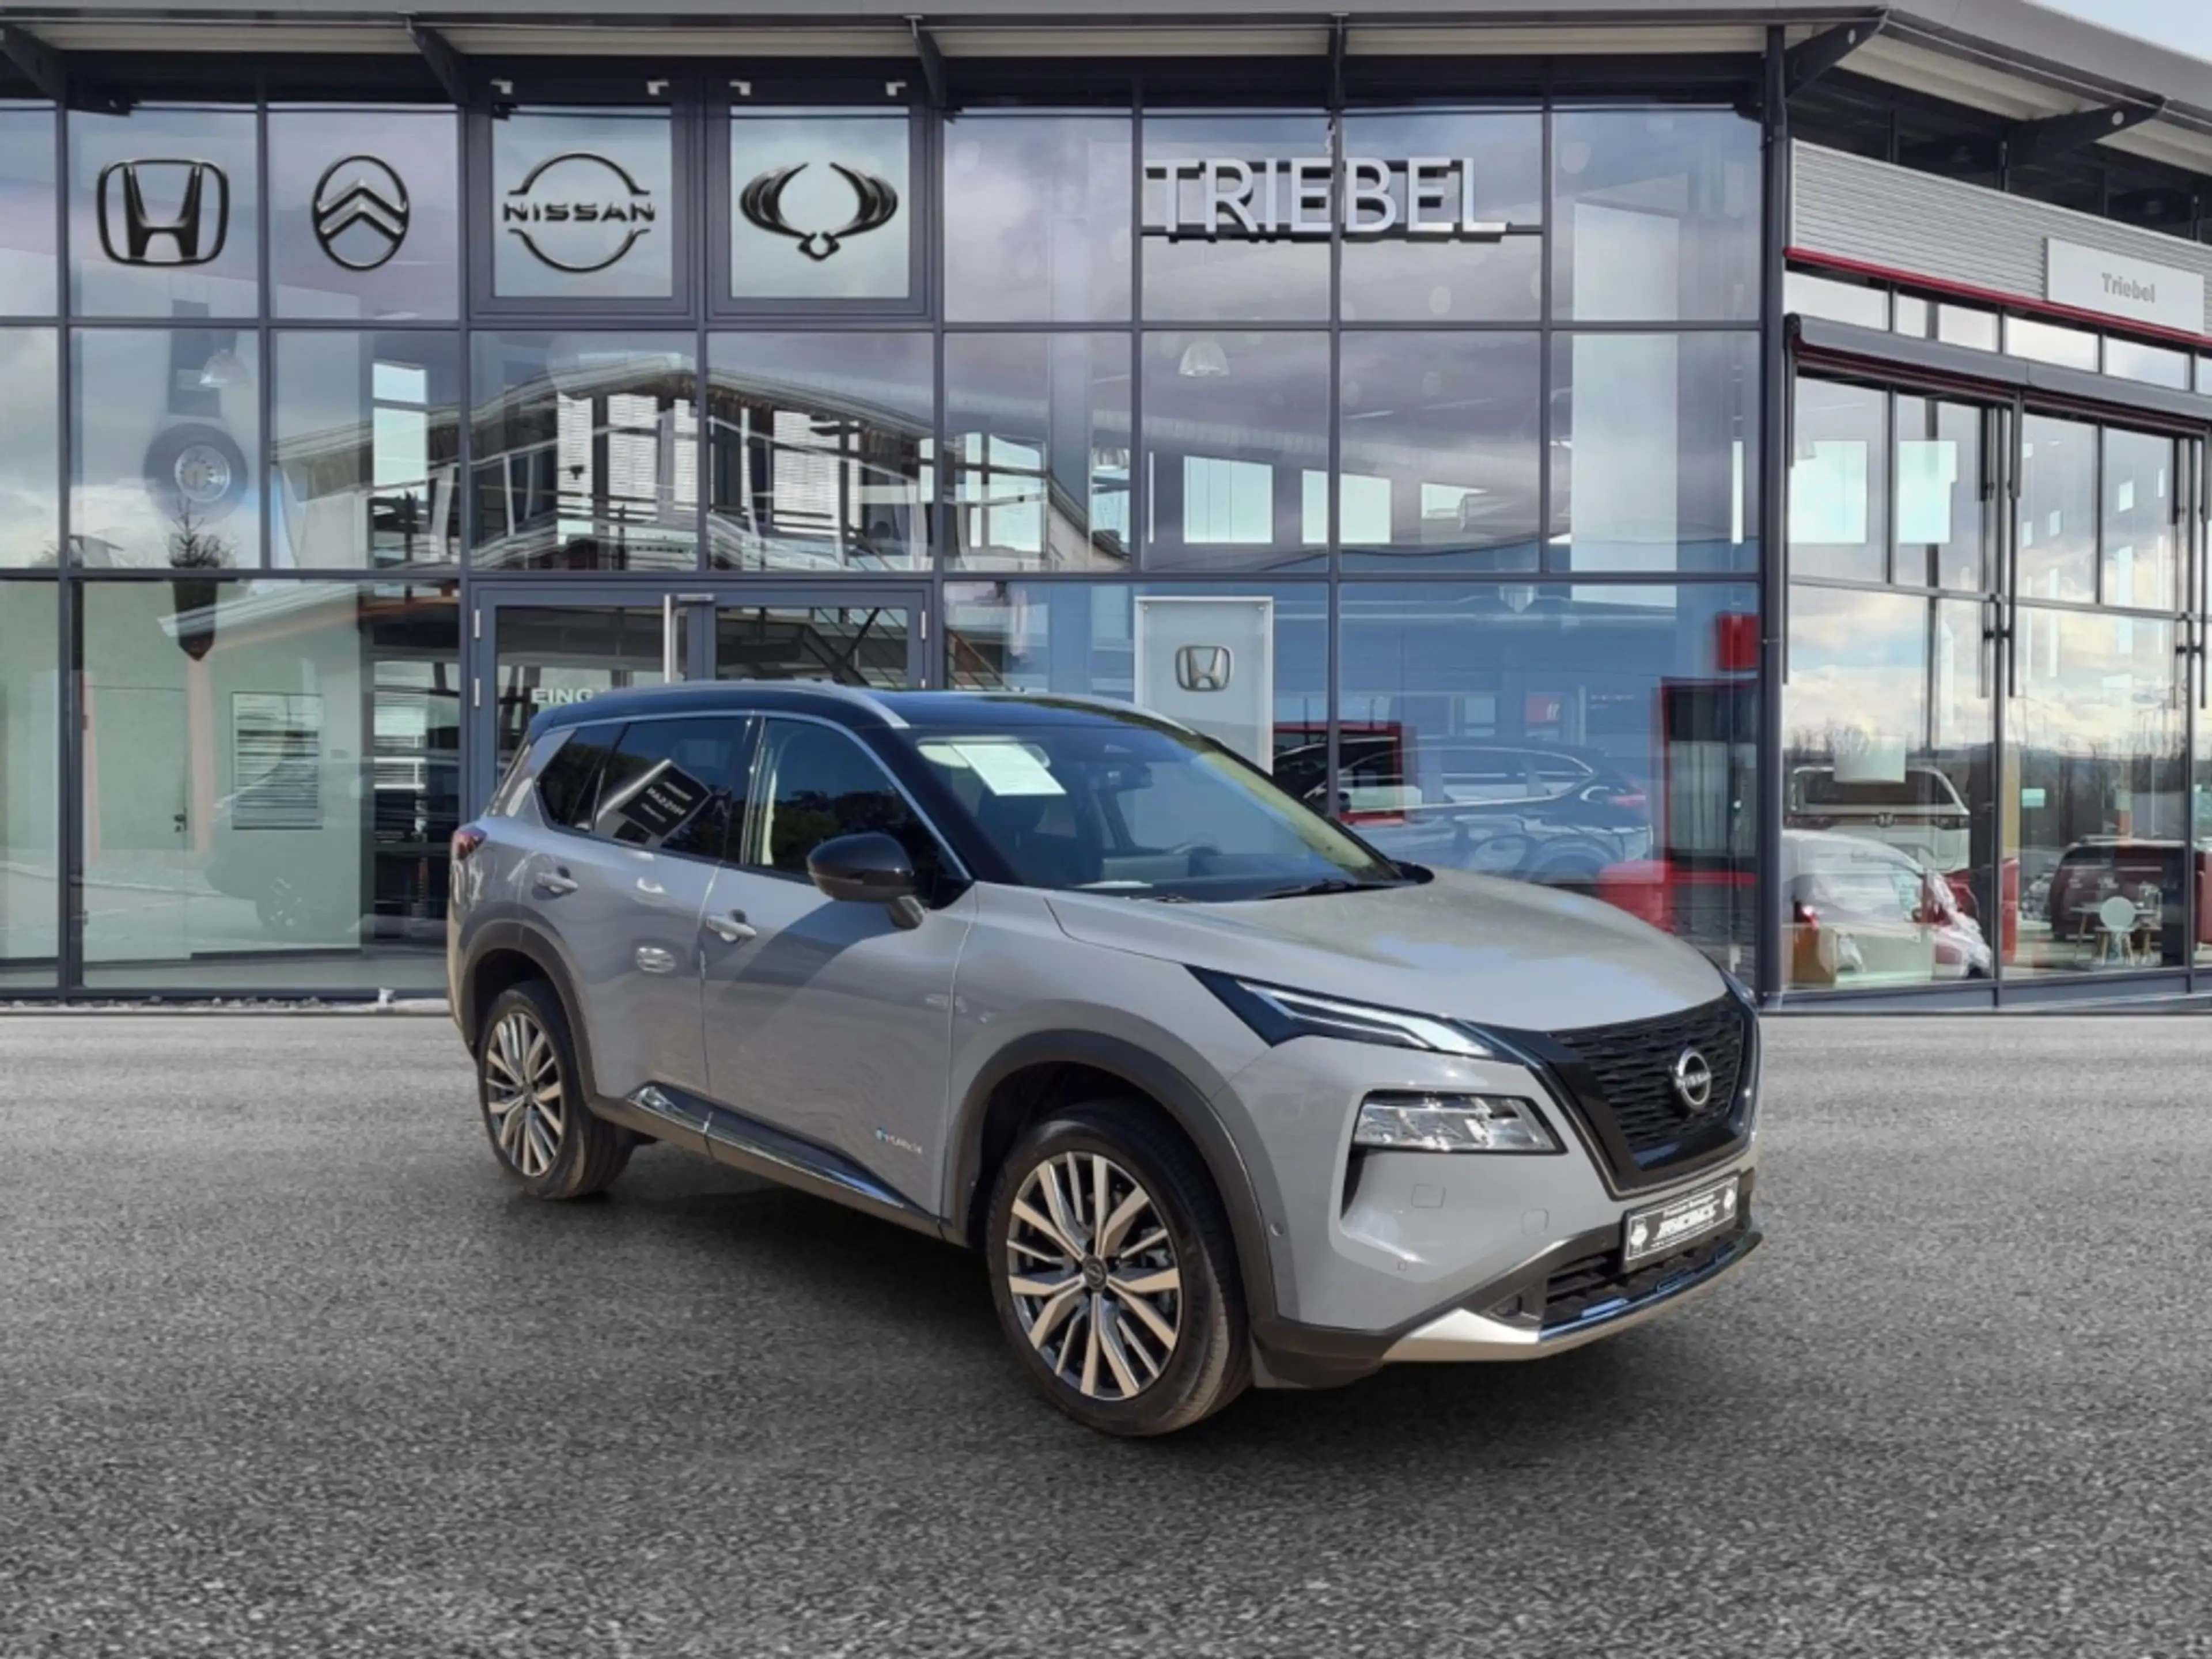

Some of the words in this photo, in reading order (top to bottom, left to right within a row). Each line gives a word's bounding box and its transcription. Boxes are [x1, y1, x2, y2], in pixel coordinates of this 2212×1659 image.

[1143, 157, 1508, 233] TRIEBEL
[502, 203, 656, 222] NISSAN
[2101, 271, 2156, 304] Triebel
[531, 687, 606, 704] EING
